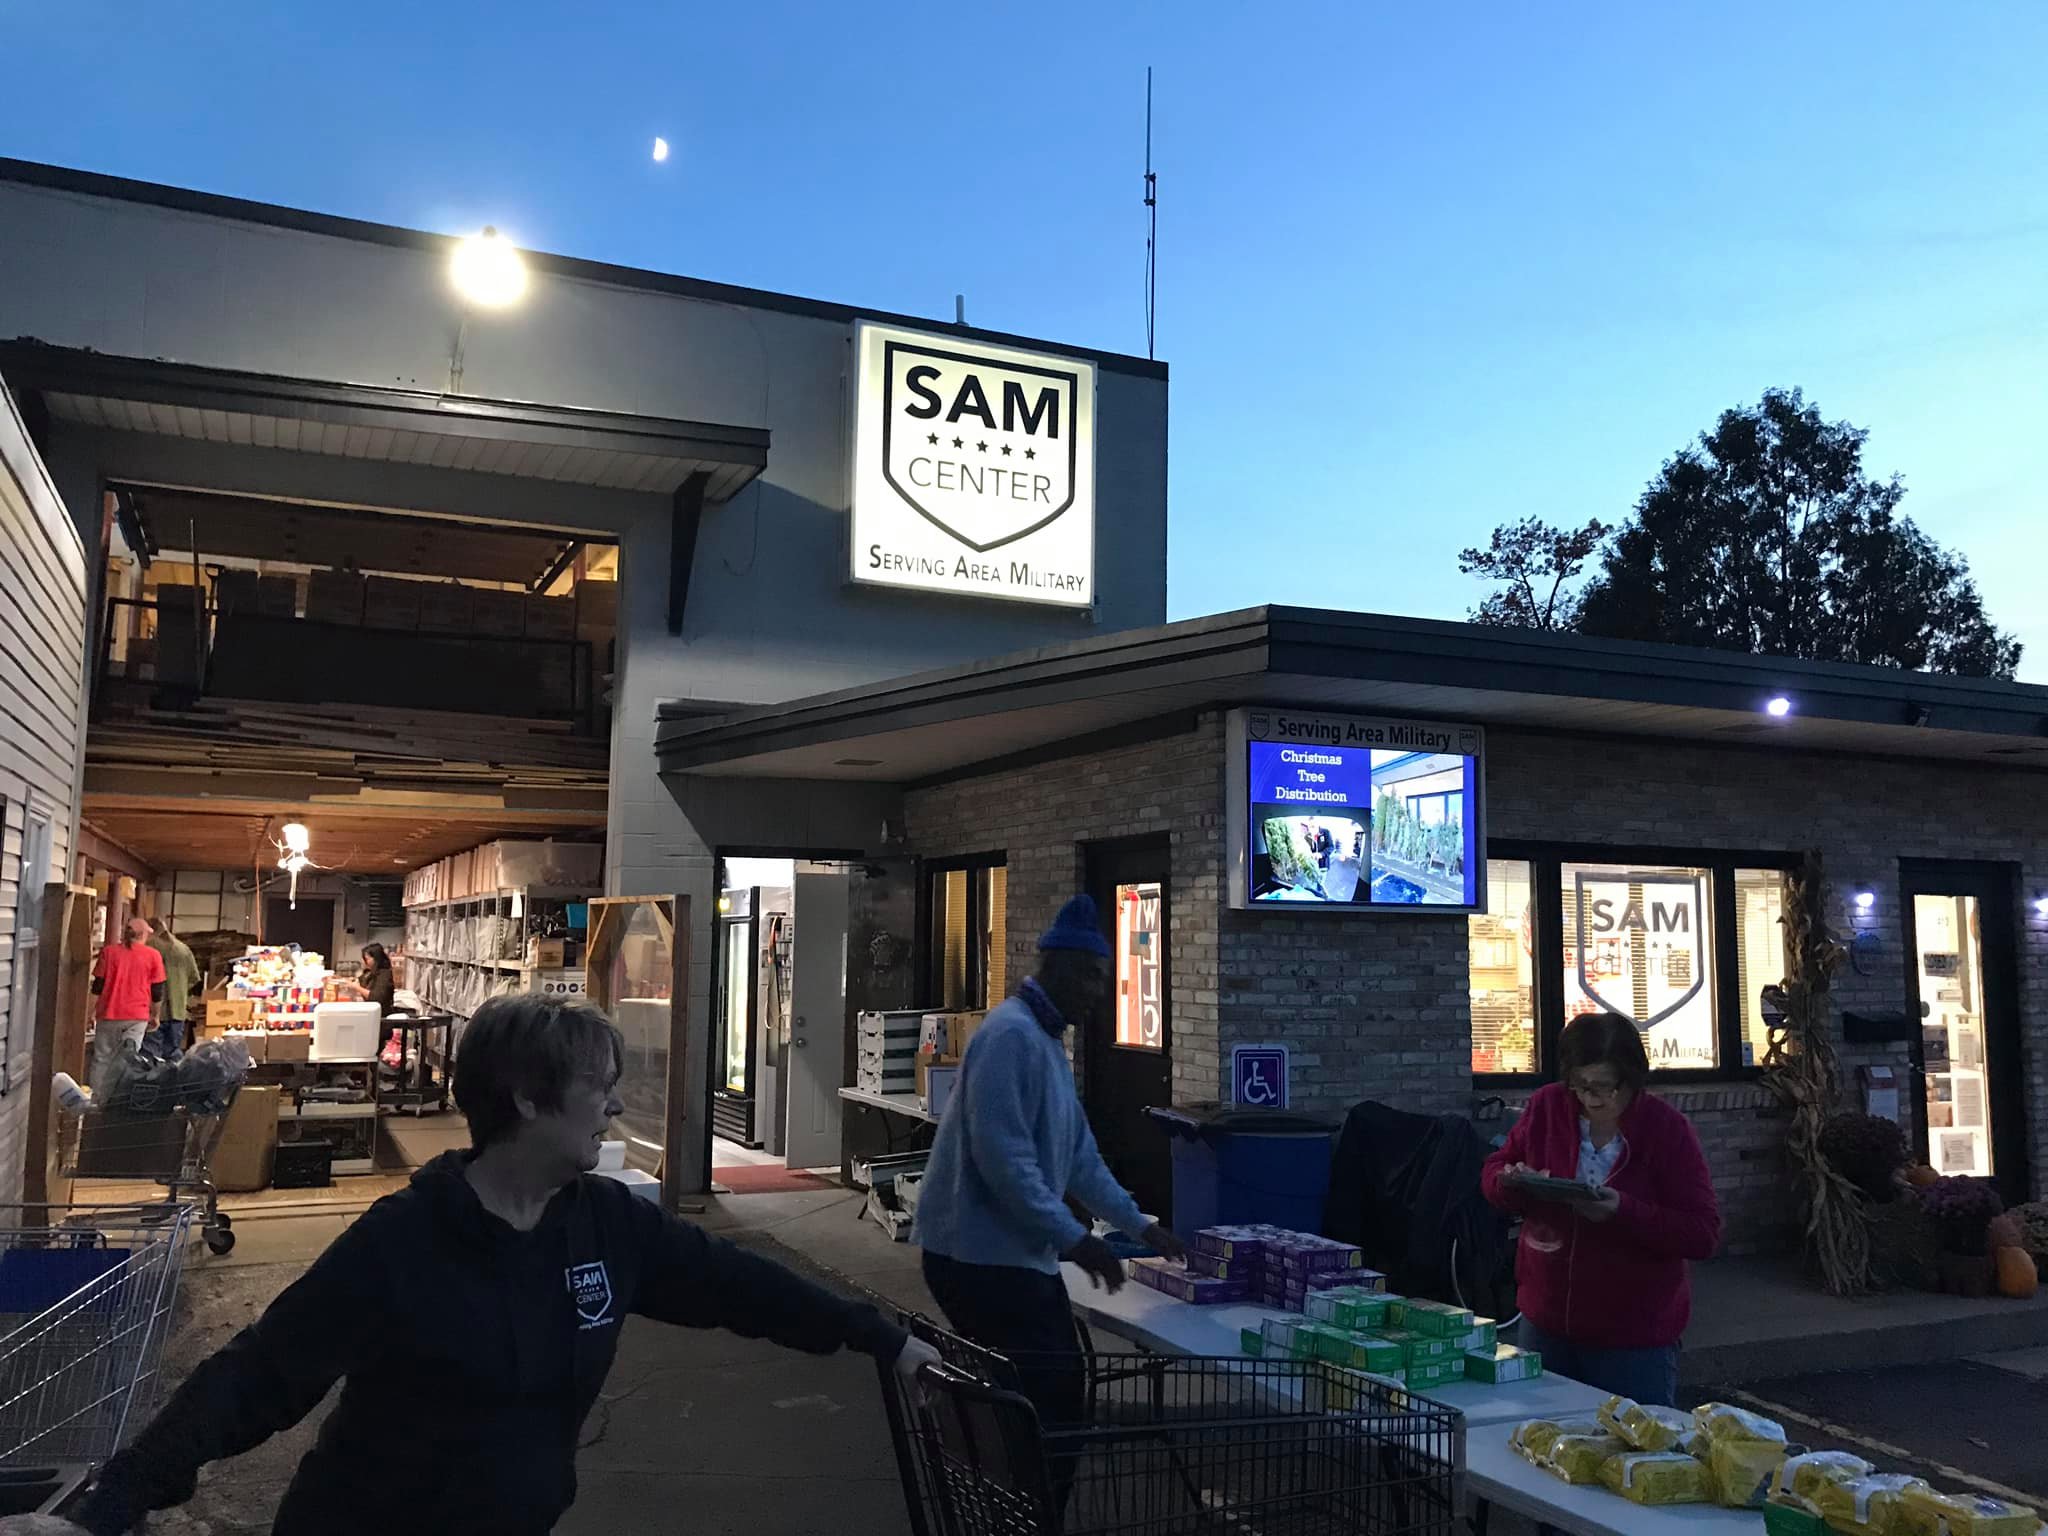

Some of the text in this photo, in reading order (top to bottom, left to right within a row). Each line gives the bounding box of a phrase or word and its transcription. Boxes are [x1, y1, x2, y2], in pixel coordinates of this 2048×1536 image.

[905, 365, 1059, 439] SAM
[909, 457, 1051, 504] CENTER
[1278, 718, 1451, 753] Serving Area Military
[1281, 749, 1342, 766] Christmas
[1297, 769, 1326, 783] Tree
[1275, 786, 1348, 803] Distribution
[1591, 899, 1690, 933] SAM
